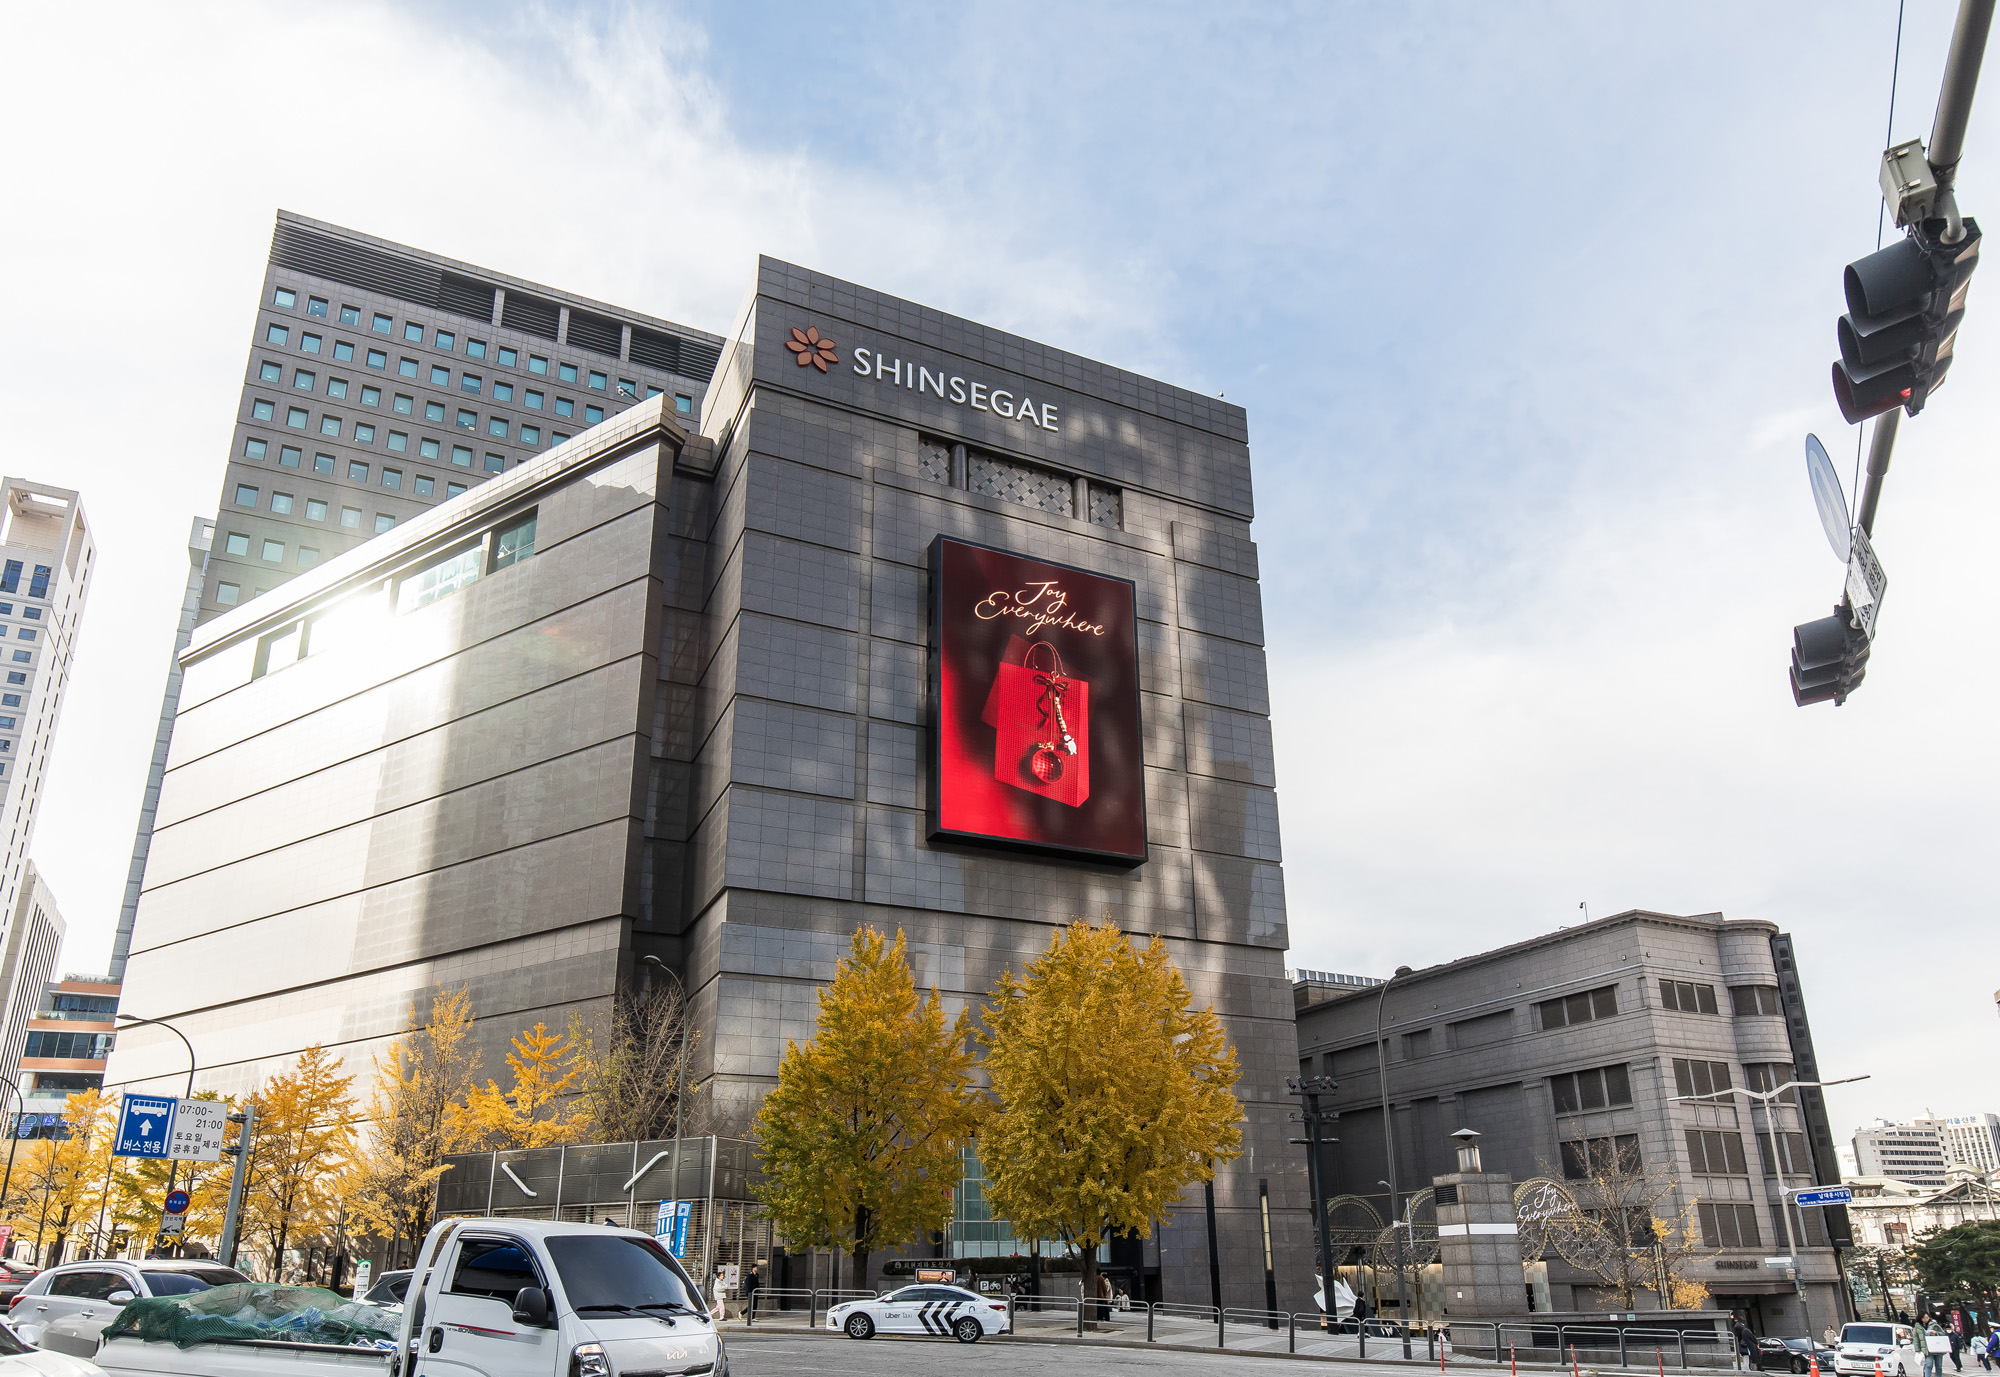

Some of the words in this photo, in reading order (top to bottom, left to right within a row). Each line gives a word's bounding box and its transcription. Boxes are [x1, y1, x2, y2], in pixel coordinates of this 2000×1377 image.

[853, 347, 1059, 432] SHINSEGAE
[1014, 581, 1068, 614] Joy
[974, 591, 1105, 636] Everywhere
[179, 1105, 213, 1116] 07:00~
[195, 1119, 223, 1129] 21:00
[175, 1132, 202, 1142] 토요일
[173, 1144, 200, 1154] 공휴일
[202, 1140, 219, 1149] 제외
[1534, 1182, 1558, 1208] Joy
